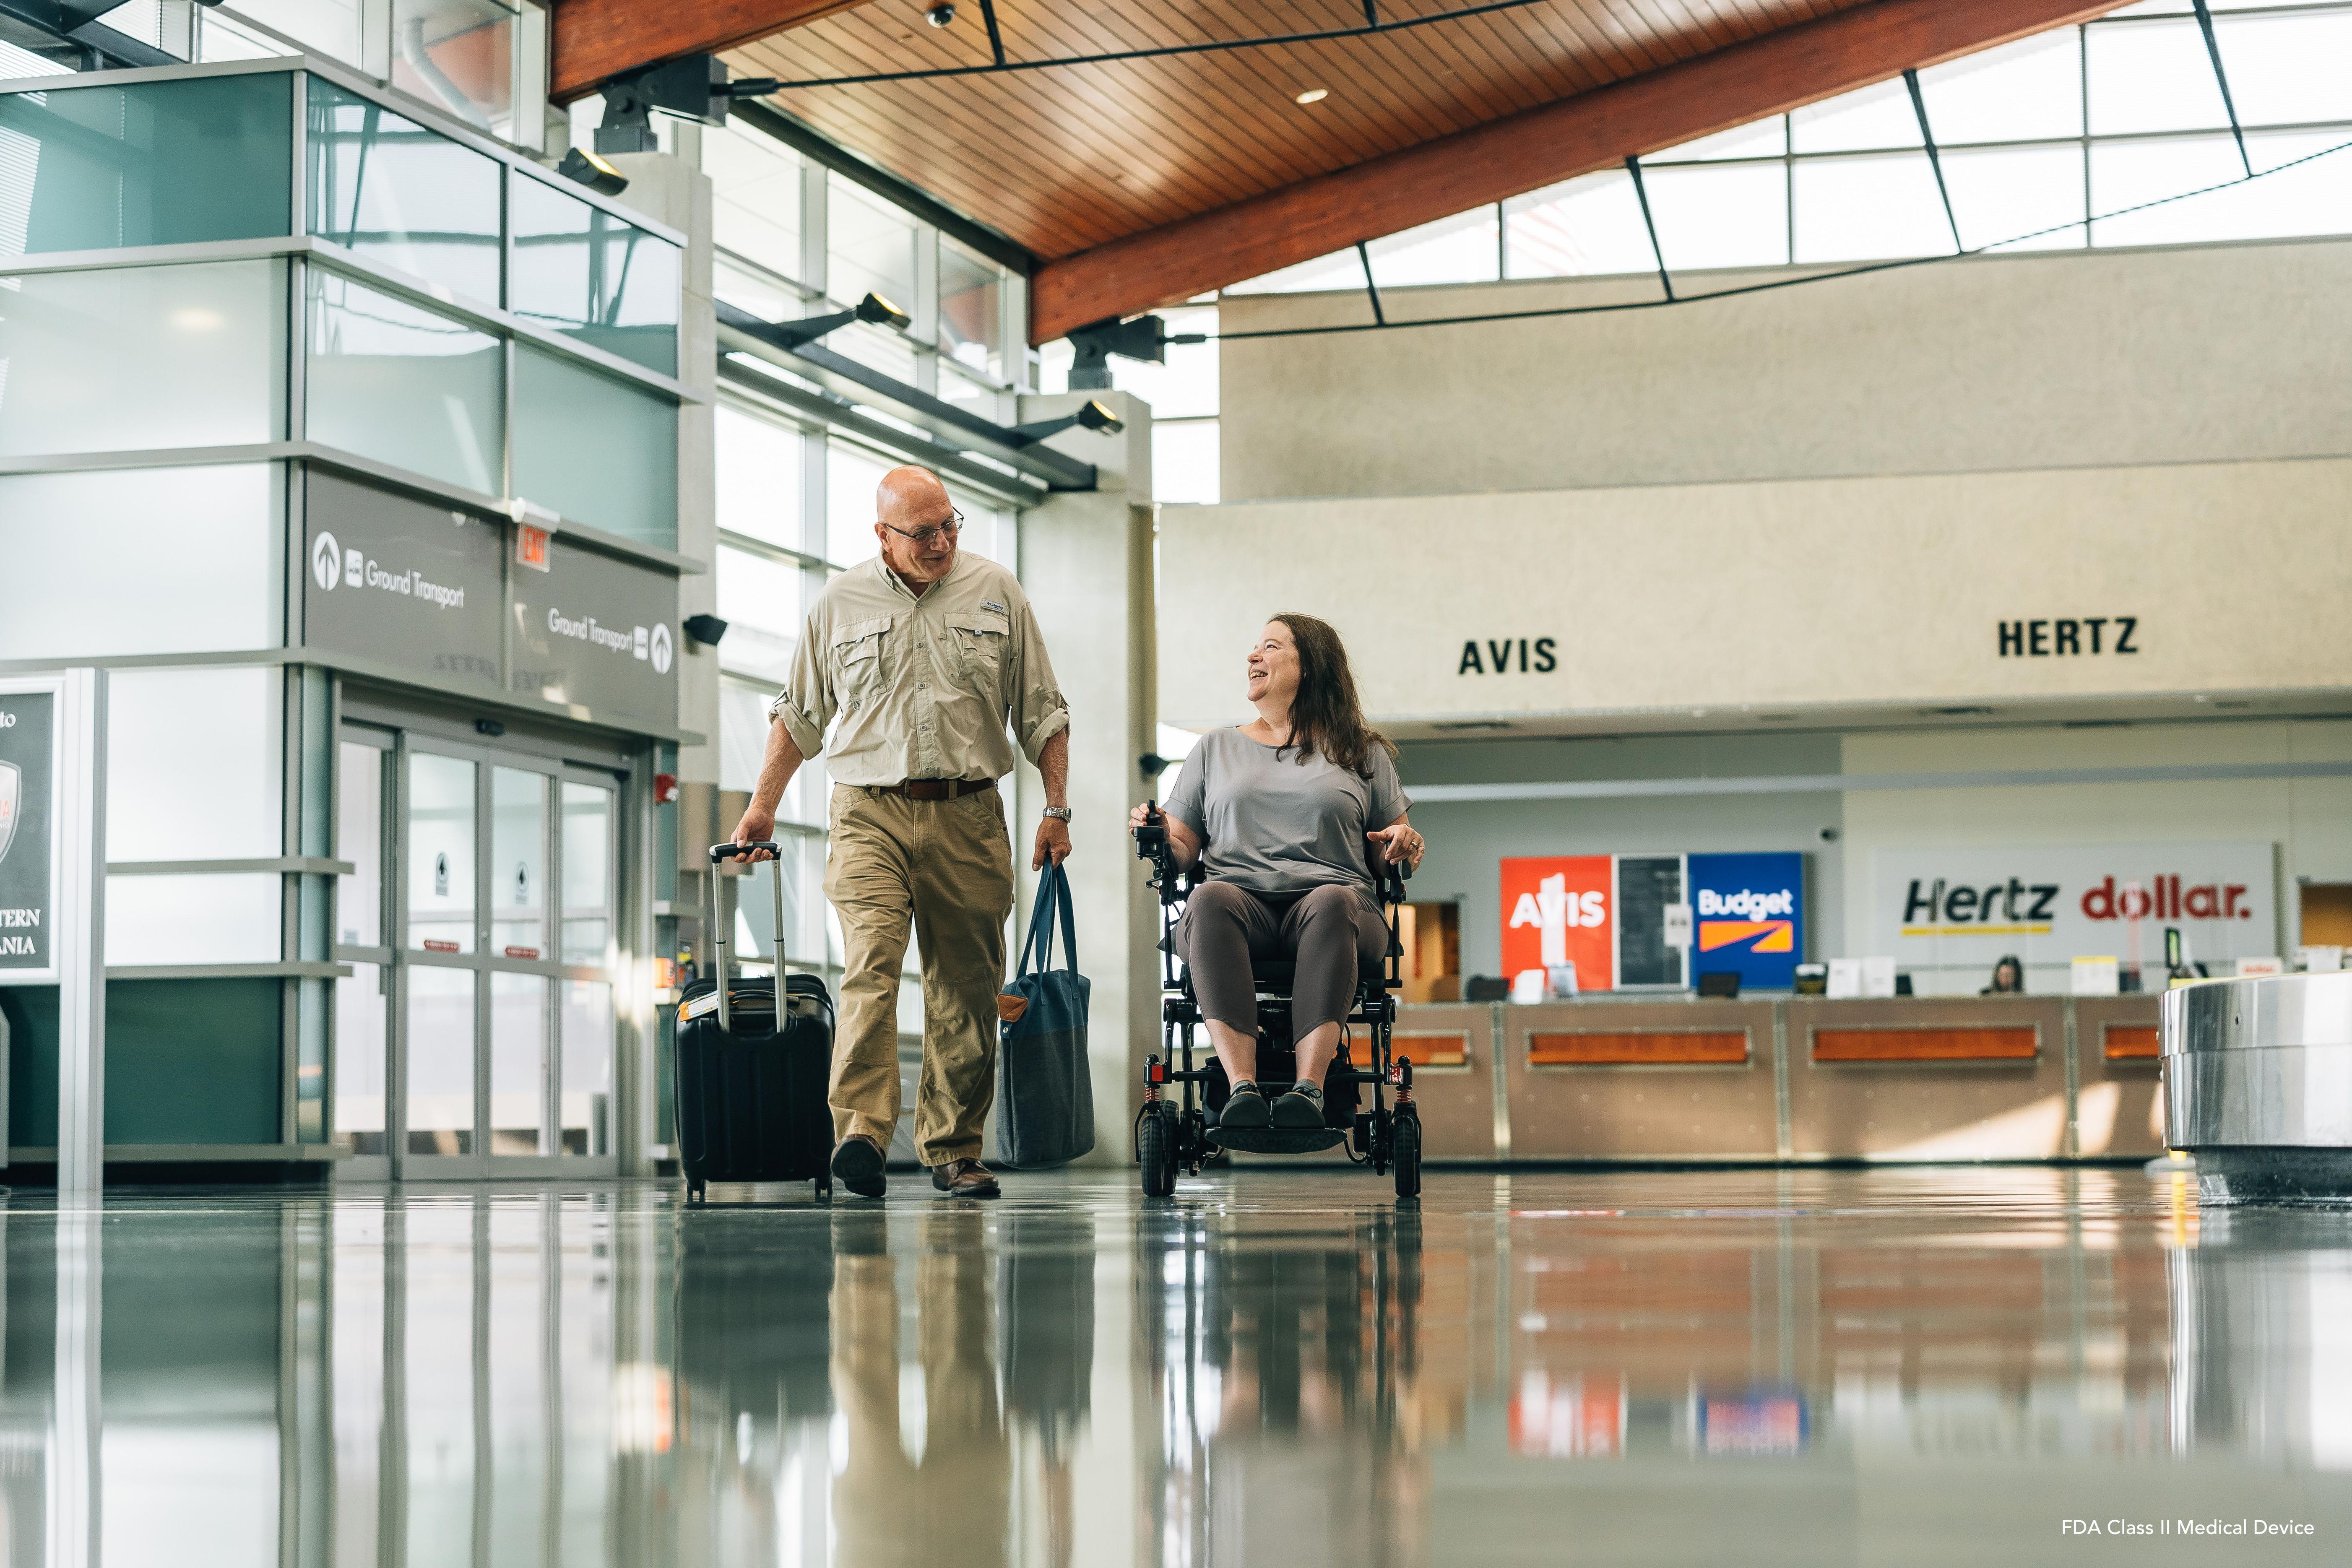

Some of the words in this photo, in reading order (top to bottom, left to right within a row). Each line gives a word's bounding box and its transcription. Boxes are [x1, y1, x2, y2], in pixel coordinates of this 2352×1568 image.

[365, 559, 411, 595] Ground
[411, 571, 464, 610] Transport
[548, 608, 587, 640] Ground
[588, 617, 632, 653] Transport
[1998, 616, 2138, 657] HERTZ
[1458, 637, 1557, 675] AVIS
[1509, 890, 1605, 928] AVIS
[1699, 889, 1793, 923] Budget
[1903, 877, 2060, 924] Hertz
[0, 936, 36, 955] NIA
